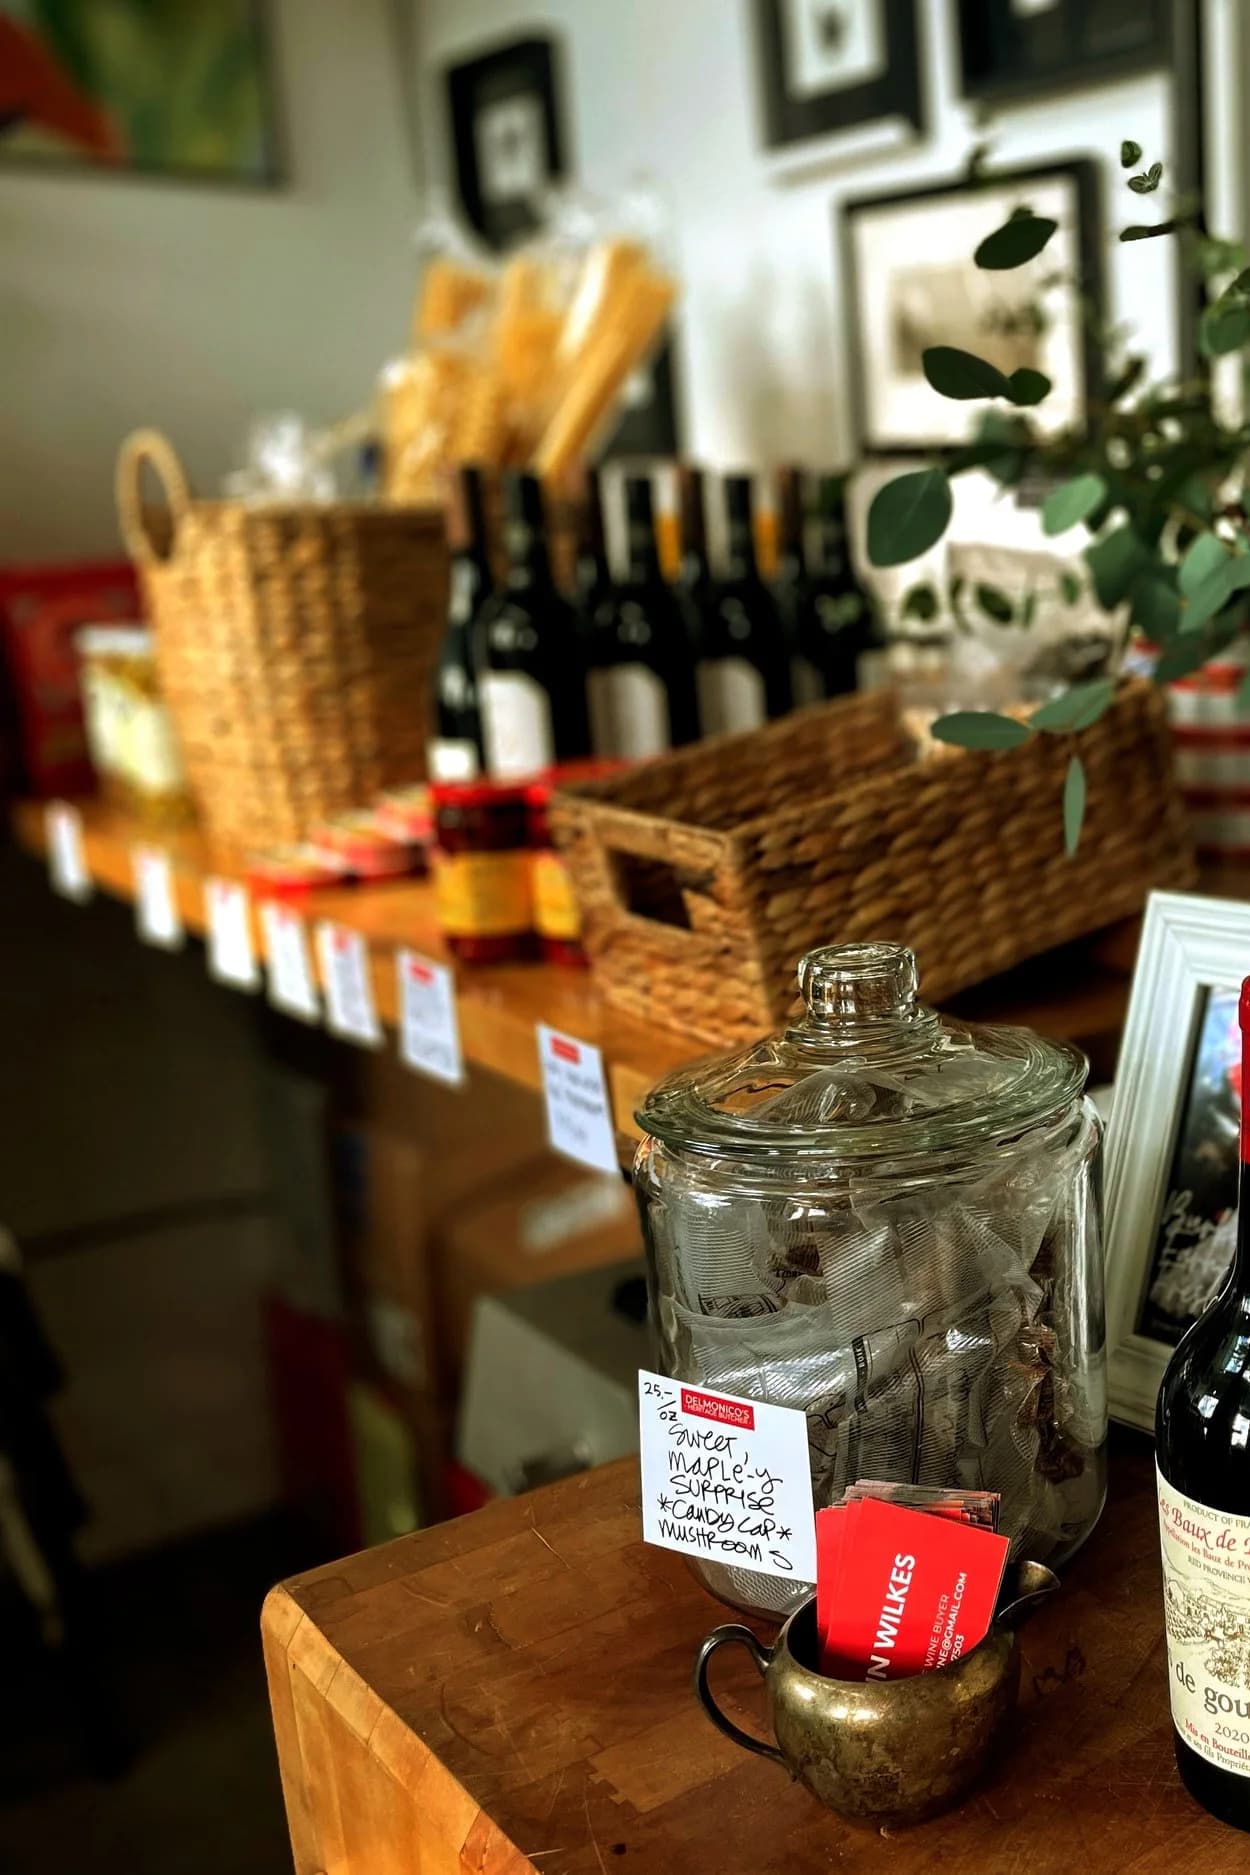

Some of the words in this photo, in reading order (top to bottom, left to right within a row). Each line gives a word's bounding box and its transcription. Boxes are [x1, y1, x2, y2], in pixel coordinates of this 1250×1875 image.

[684, 1394, 751, 1420] DELMONICO'S
[1160, 1498, 1170, 1516] es
[1171, 1507, 1214, 1551] Baux
[1216, 1528, 1237, 1552] de
[1183, 1500, 1219, 1522] PRODUCT
[1220, 1516, 1234, 1526] OF
[1202, 1564, 1246, 1585] PROVENCE
[1224, 1556, 1234, 1567] de
[873, 1552, 917, 1649] WILKES
[924, 1635, 939, 1667] WINE
[932, 1594, 950, 1634] BUYER
[1175, 1661, 1196, 1694] de
[1184, 1718, 1198, 1737] Mis
[1200, 1733, 1210, 1745] en
[1214, 1721, 1250, 1745] 2020
